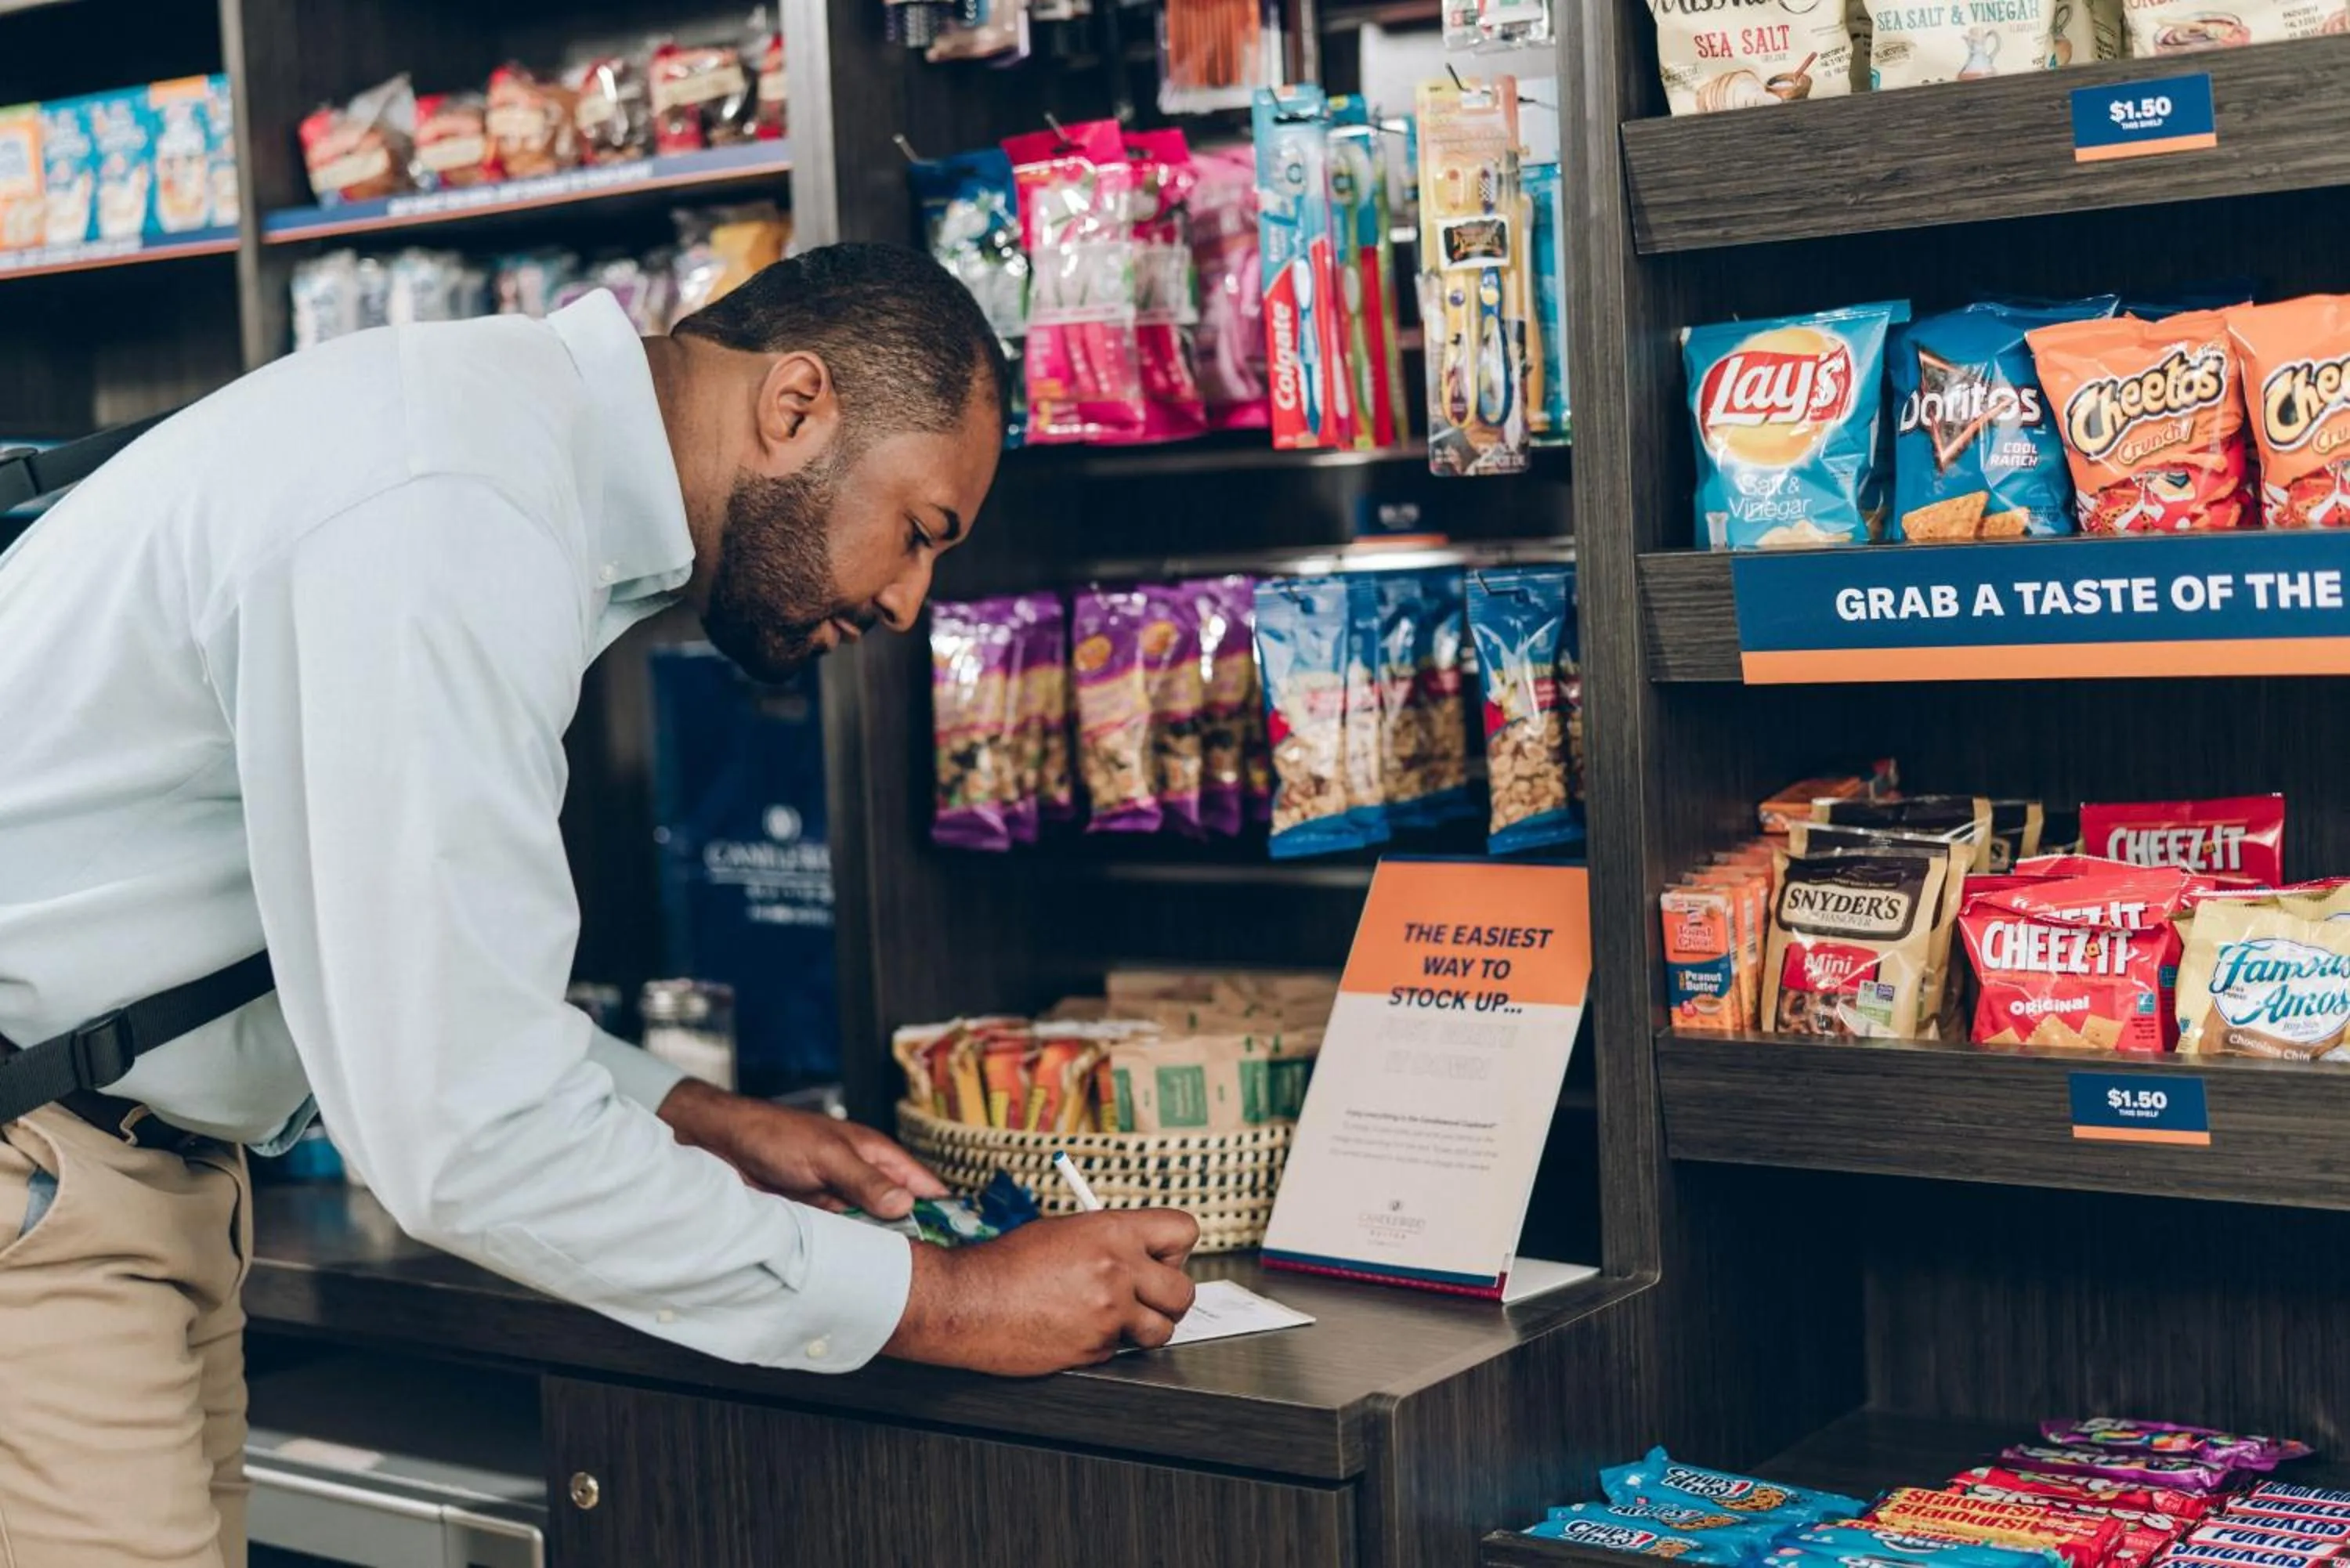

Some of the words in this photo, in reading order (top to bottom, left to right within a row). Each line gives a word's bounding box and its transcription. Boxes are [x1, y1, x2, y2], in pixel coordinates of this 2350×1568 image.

[1876, 9, 1904, 32] SEA
[1907, 6, 1945, 29] SALT
[1950, 5, 1965, 27] &
[1694, 32, 1734, 59] SEA
[1741, 24, 1790, 56] SALT
[2110, 96, 2172, 123] $1.50
[1272, 300, 1297, 411] Colgate
[1707, 352, 1846, 427] Lay's
[1900, 381, 2042, 432] Doritos
[2066, 350, 2225, 457] Cheetos
[1990, 453, 2038, 467] RANCH
[2003, 442, 2037, 454] COOL
[1727, 497, 1812, 520] Vinegar
[1835, 585, 1960, 621] GRAB
[1972, 583, 2005, 617] A
[2014, 578, 2159, 616] TASTE
[2171, 575, 2234, 612] OF
[2245, 570, 2344, 610] THE
[1788, 887, 1902, 921] SNYDER'S
[1404, 922, 1448, 944] THE
[1452, 924, 1554, 948] EASIEST
[1423, 955, 1475, 977] WAY
[1481, 958, 1512, 980] TO
[1684, 970, 1723, 983] Peanut
[1804, 952, 1853, 976] Mini
[1387, 986, 1470, 1010] STOCK
[1474, 992, 1523, 1014] UP...
[1685, 981, 1720, 992] Butter
[2231, 983, 2350, 1025] Amos
[2229, 1033, 2282, 1057] Chocolate
[2107, 1087, 2168, 1109] $1.50
